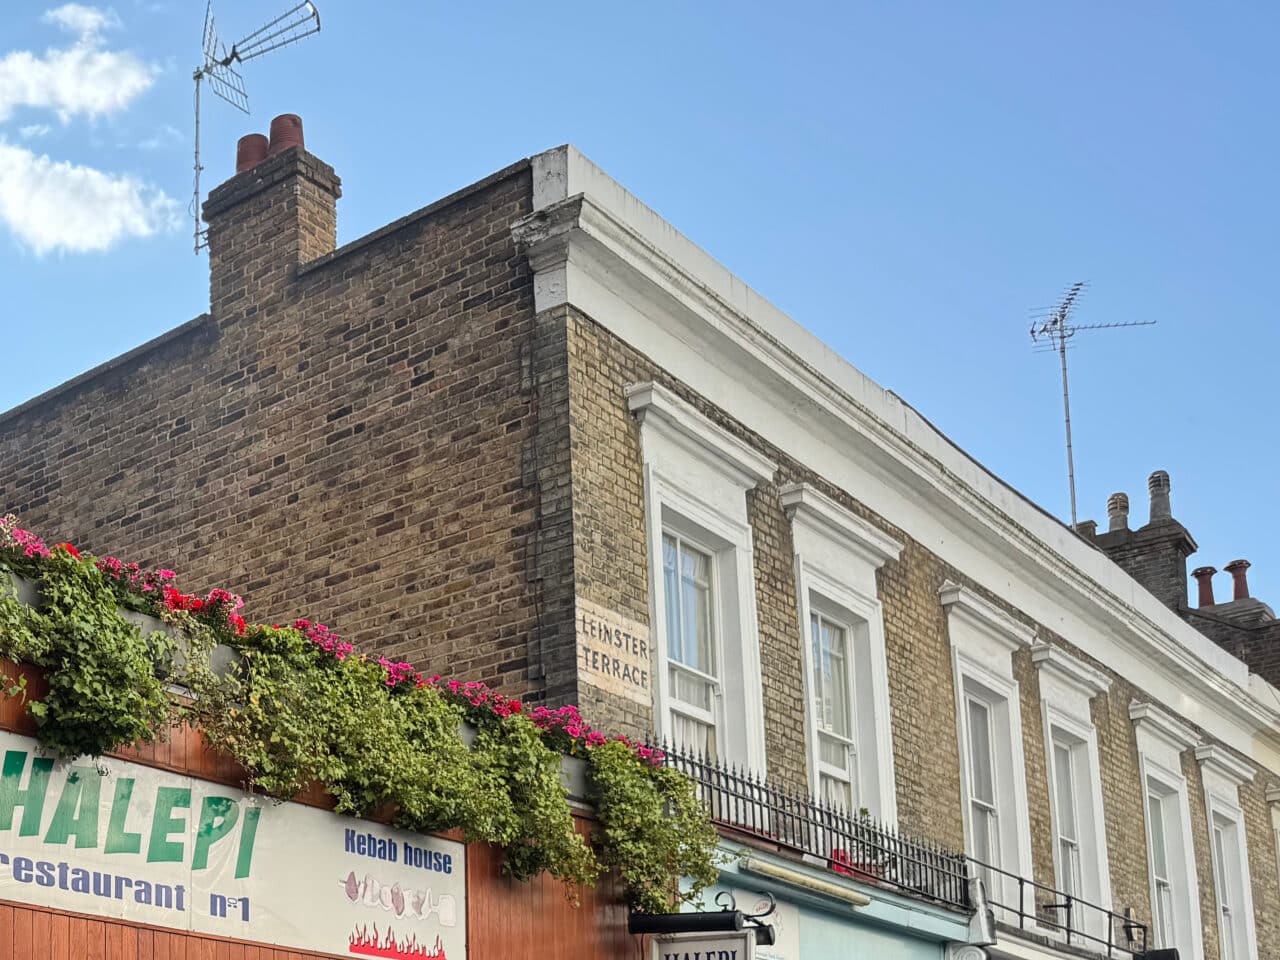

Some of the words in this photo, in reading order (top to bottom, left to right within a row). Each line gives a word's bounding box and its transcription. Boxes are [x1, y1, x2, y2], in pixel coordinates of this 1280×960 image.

[582, 614, 648, 660] LEINSTER
[582, 646, 648, 690] TERRACE
[344, 828, 398, 862] Kebab
[403, 842, 453, 874] house
